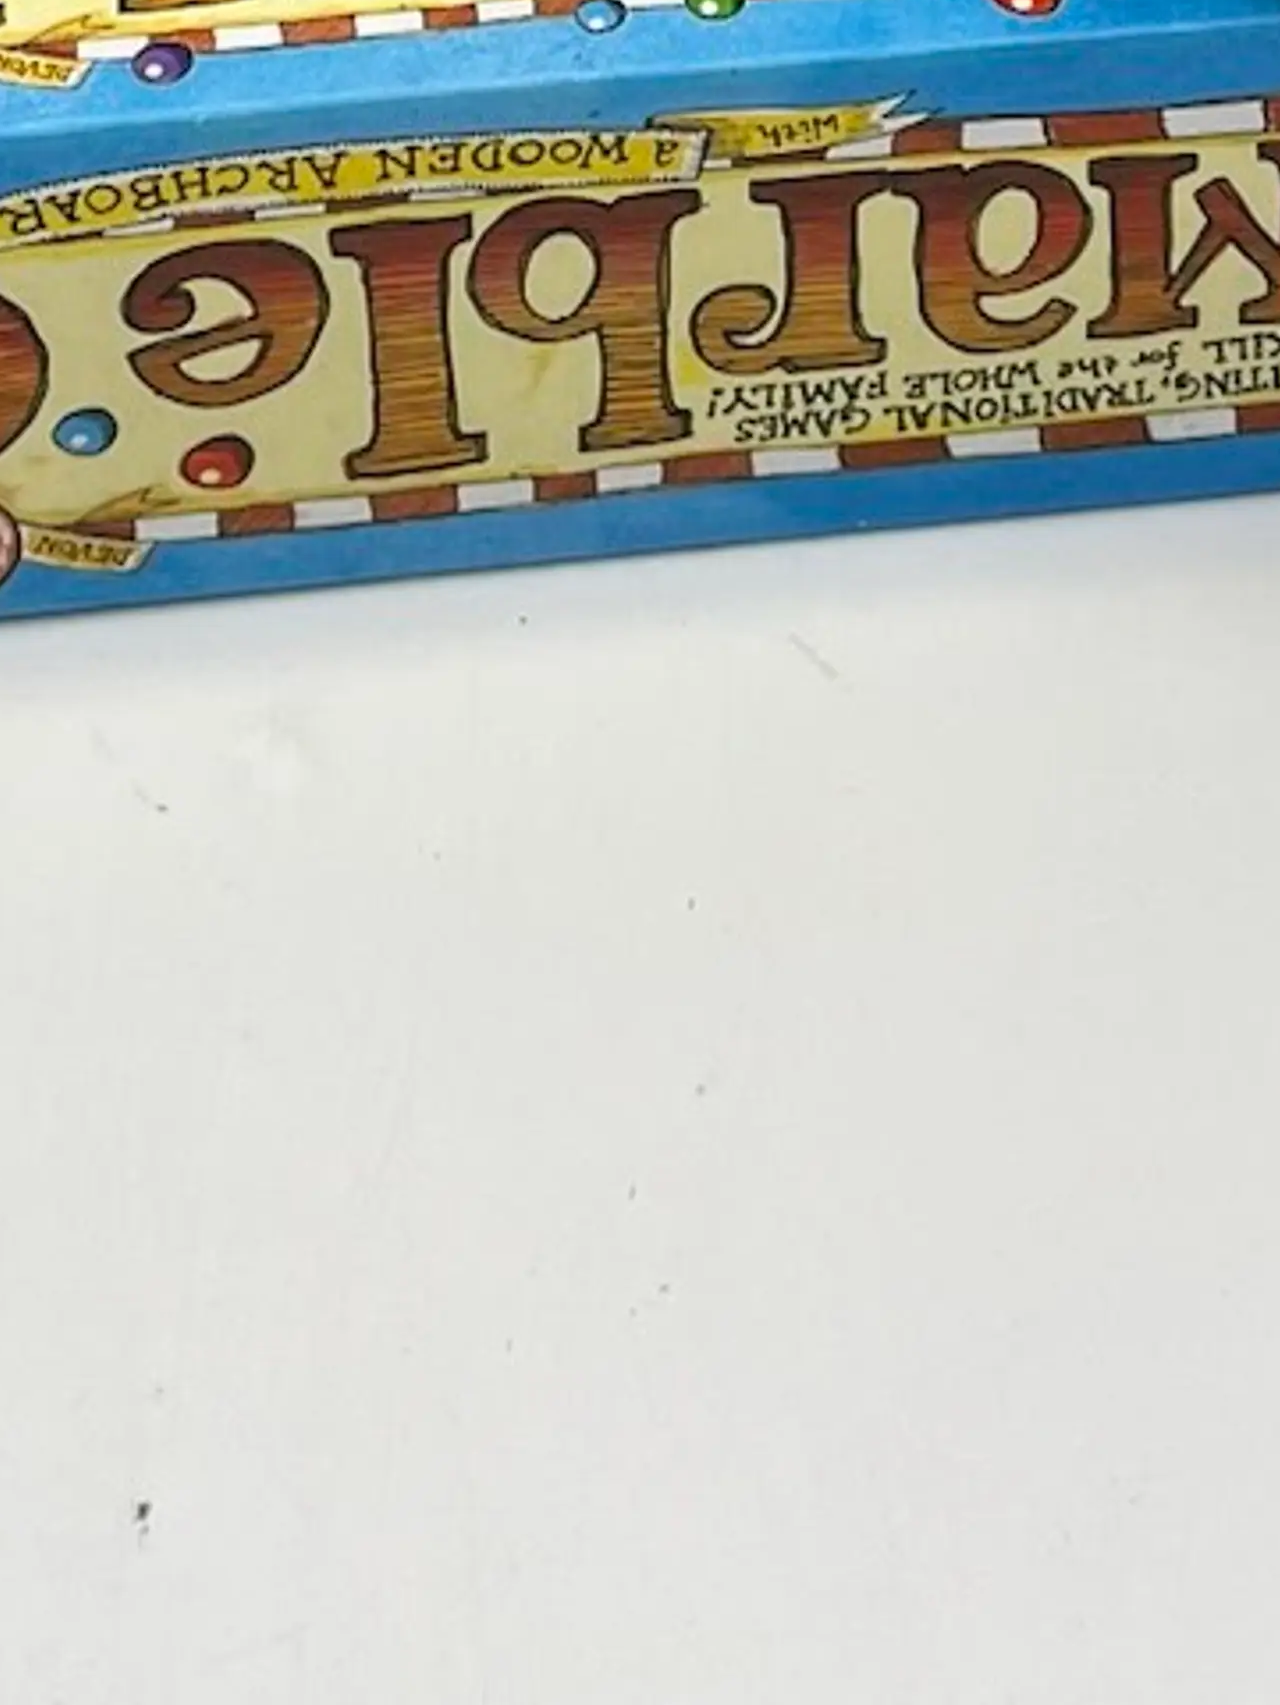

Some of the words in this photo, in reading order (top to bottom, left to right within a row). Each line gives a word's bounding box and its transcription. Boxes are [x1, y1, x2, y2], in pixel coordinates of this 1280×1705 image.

[376, 131, 629, 180] WOODEN
[1057, 350, 1118, 378] the
[1128, 341, 1182, 372] for
[903, 360, 1043, 397] WHOLE
[734, 406, 875, 444] GAMES
